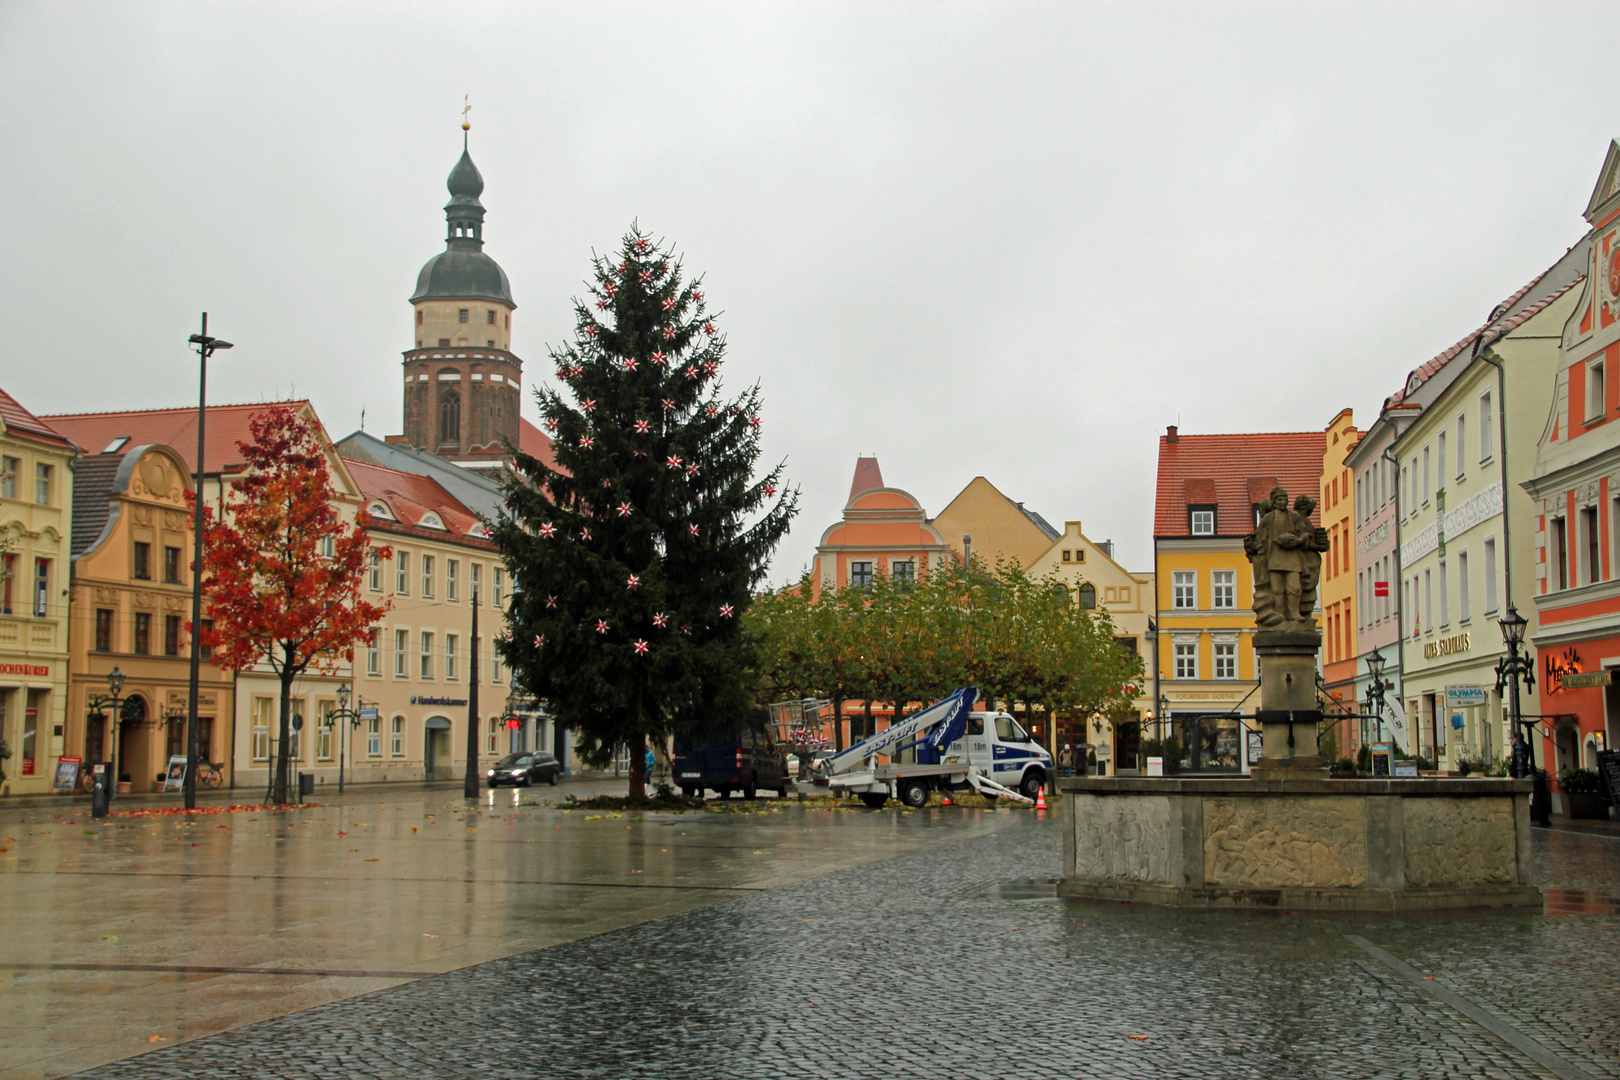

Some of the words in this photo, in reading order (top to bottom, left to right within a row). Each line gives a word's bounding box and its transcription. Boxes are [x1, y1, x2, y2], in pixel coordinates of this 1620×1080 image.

[1448, 689, 1483, 698] OLYMPIA
[950, 742, 962, 751] 18m
[974, 742, 987, 751] 18m
